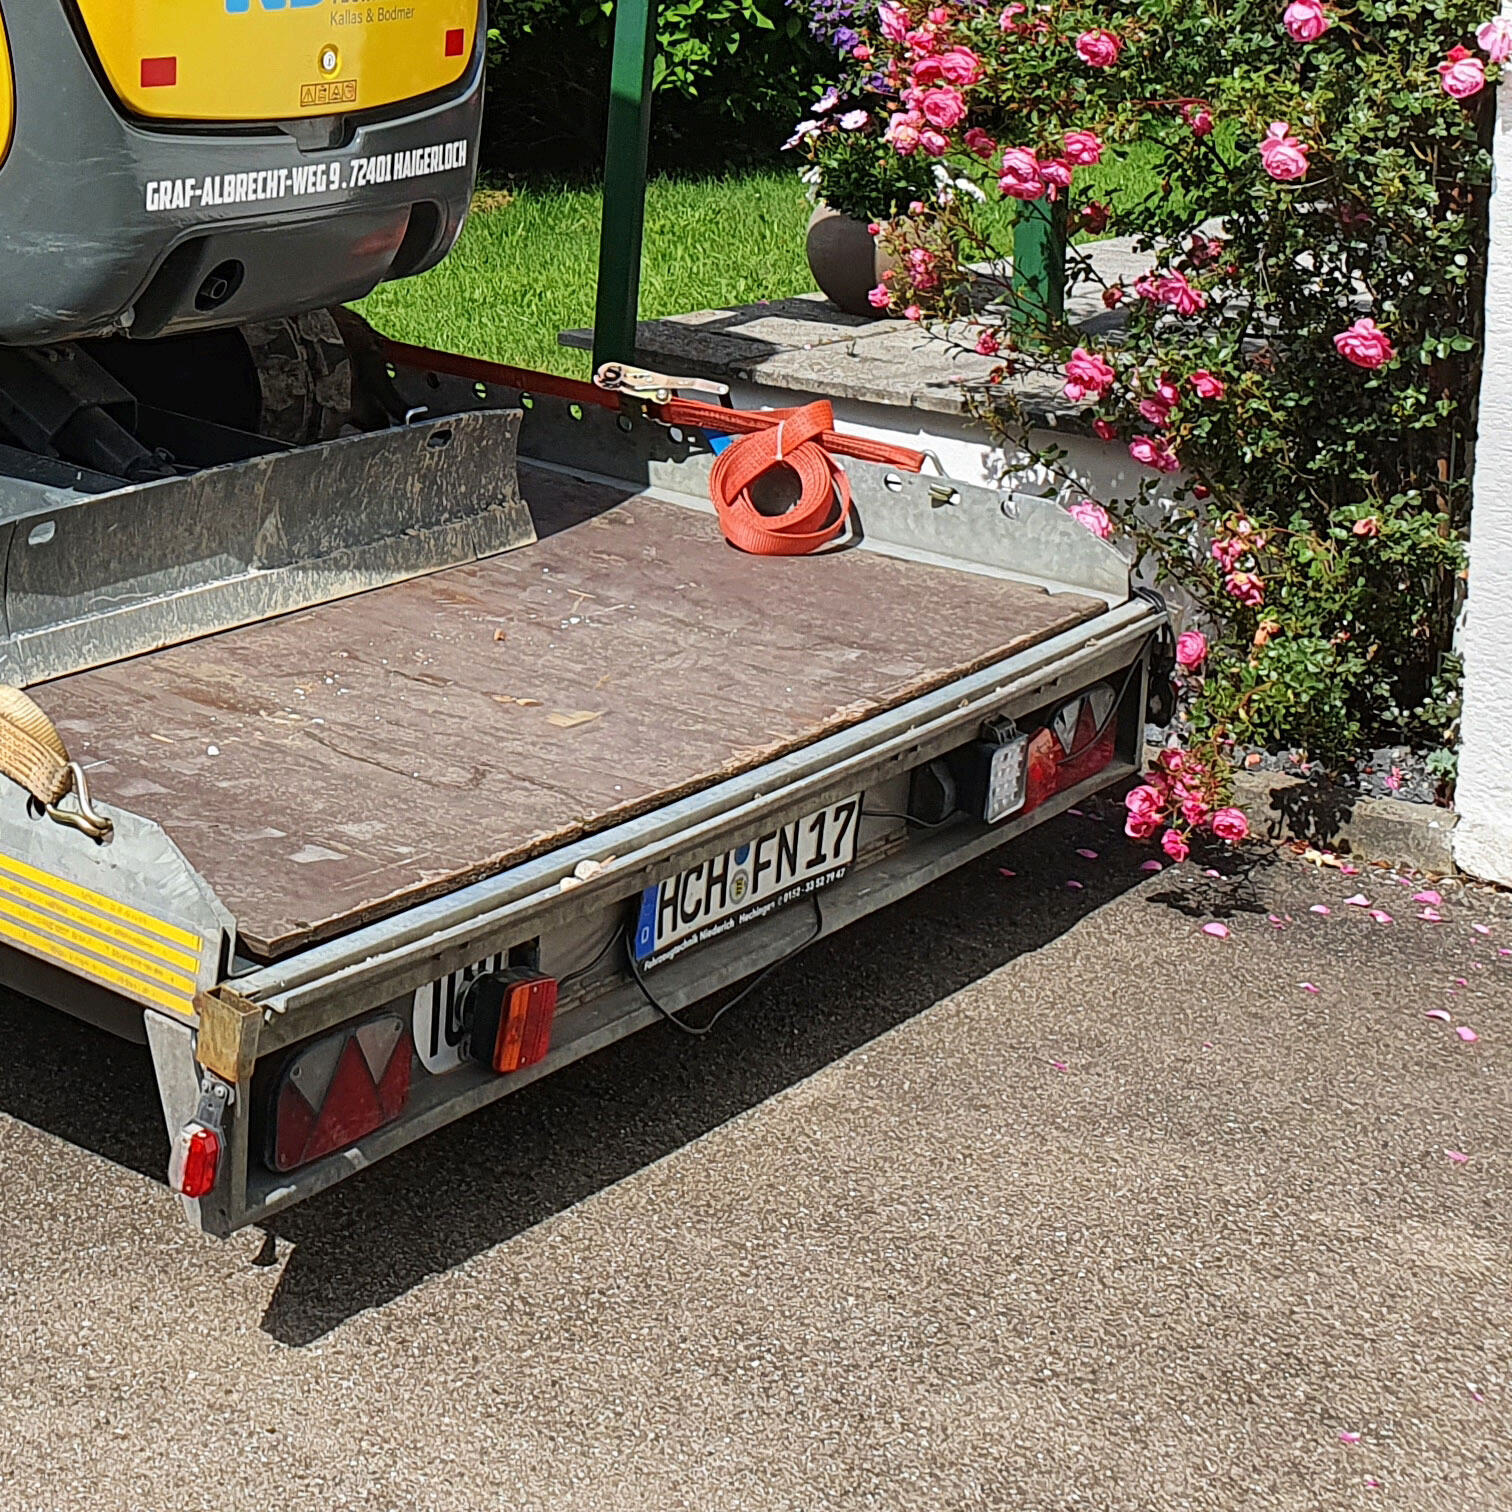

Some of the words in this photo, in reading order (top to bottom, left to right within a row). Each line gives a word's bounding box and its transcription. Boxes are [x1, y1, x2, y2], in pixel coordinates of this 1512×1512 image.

[330, 11, 363, 26] Kallas
[366, 8, 374, 23] &
[146, 163, 327, 211] GRAF-ALBRECHT-WEG
[329, 161, 340, 190] 9
[349, 153, 392, 187] 72401
[393, 140, 467, 180] HAIGERLOCH
[641, 926, 649, 944] D
[657, 852, 730, 941] HCH
[751, 820, 800, 895] FN
[805, 800, 857, 869] 17
